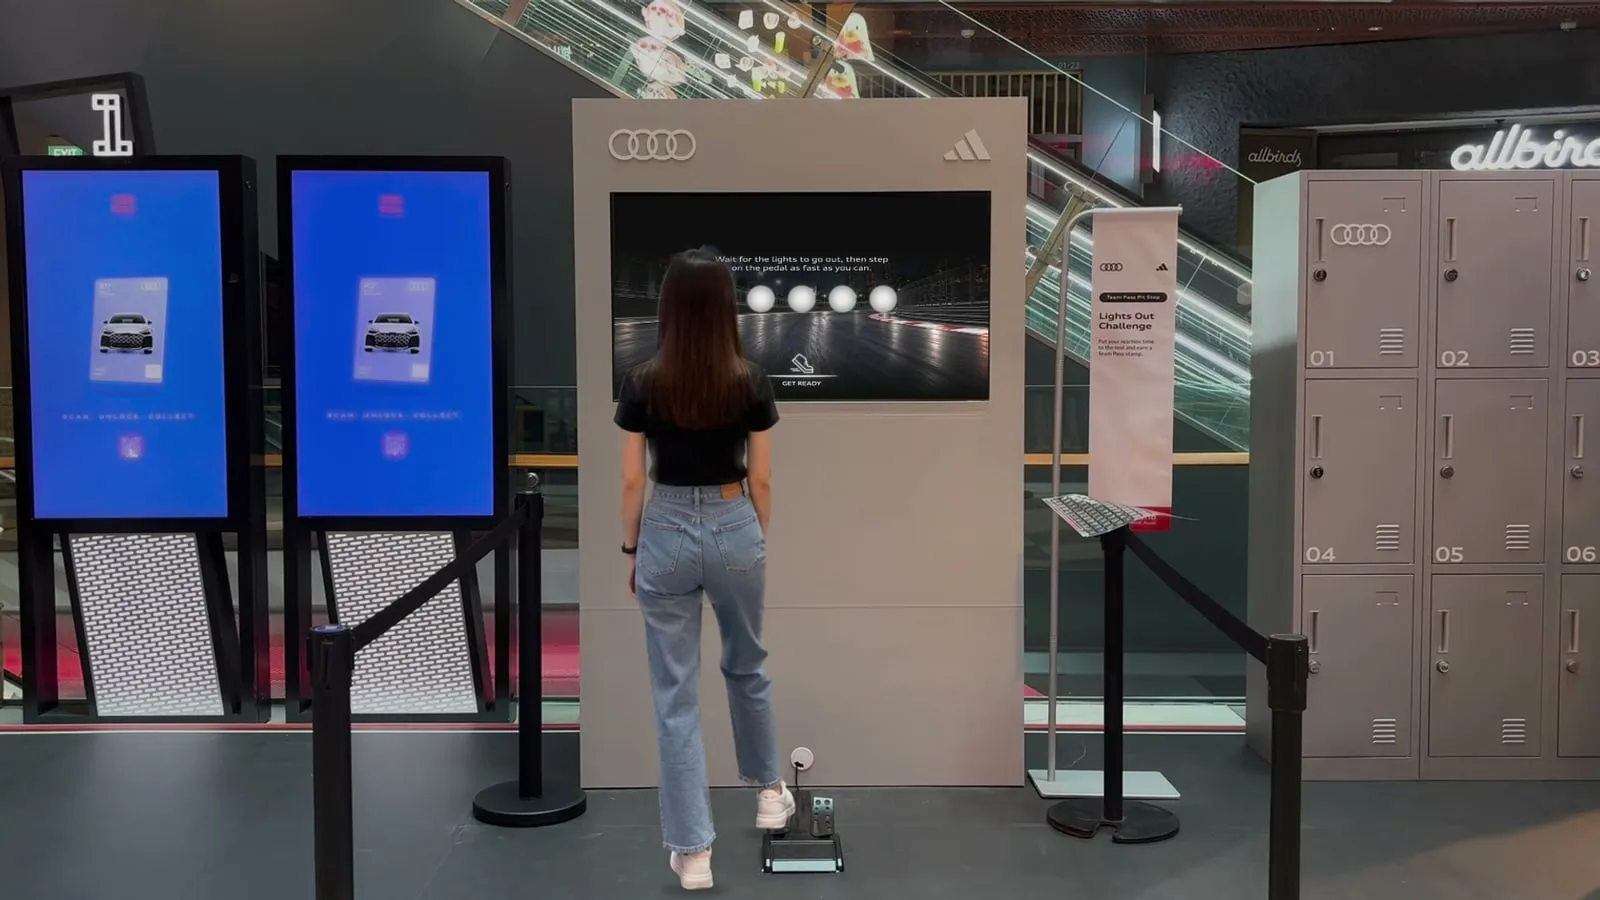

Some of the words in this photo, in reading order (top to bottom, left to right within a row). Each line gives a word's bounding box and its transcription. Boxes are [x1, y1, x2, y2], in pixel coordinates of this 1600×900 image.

[92, 93, 133, 156] 1
[1248, 146, 1302, 168] allbirds
[714, 255, 737, 263] Wait
[739, 255, 752, 263] for
[754, 255, 769, 263] the
[772, 255, 798, 265] lights
[811, 256, 824, 265] go
[825, 256, 844, 264] out,
[846, 255, 867, 263] then
[868, 256, 889, 264] step
[745, 264, 760, 272] the
[762, 264, 788, 273] pedal
[802, 264, 820, 272] fast
[834, 265, 851, 273] you
[1099, 312, 1132, 321] Lights
[1135, 312, 1155, 320] Out
[1099, 322, 1152, 331] Challenge
[1310, 350, 1335, 366] 01
[1441, 350, 1470, 366] 02
[1572, 350, 1600, 366] 03
[1306, 546, 1336, 563] 04
[1435, 546, 1464, 563] 05
[1566, 546, 1597, 562] 06
